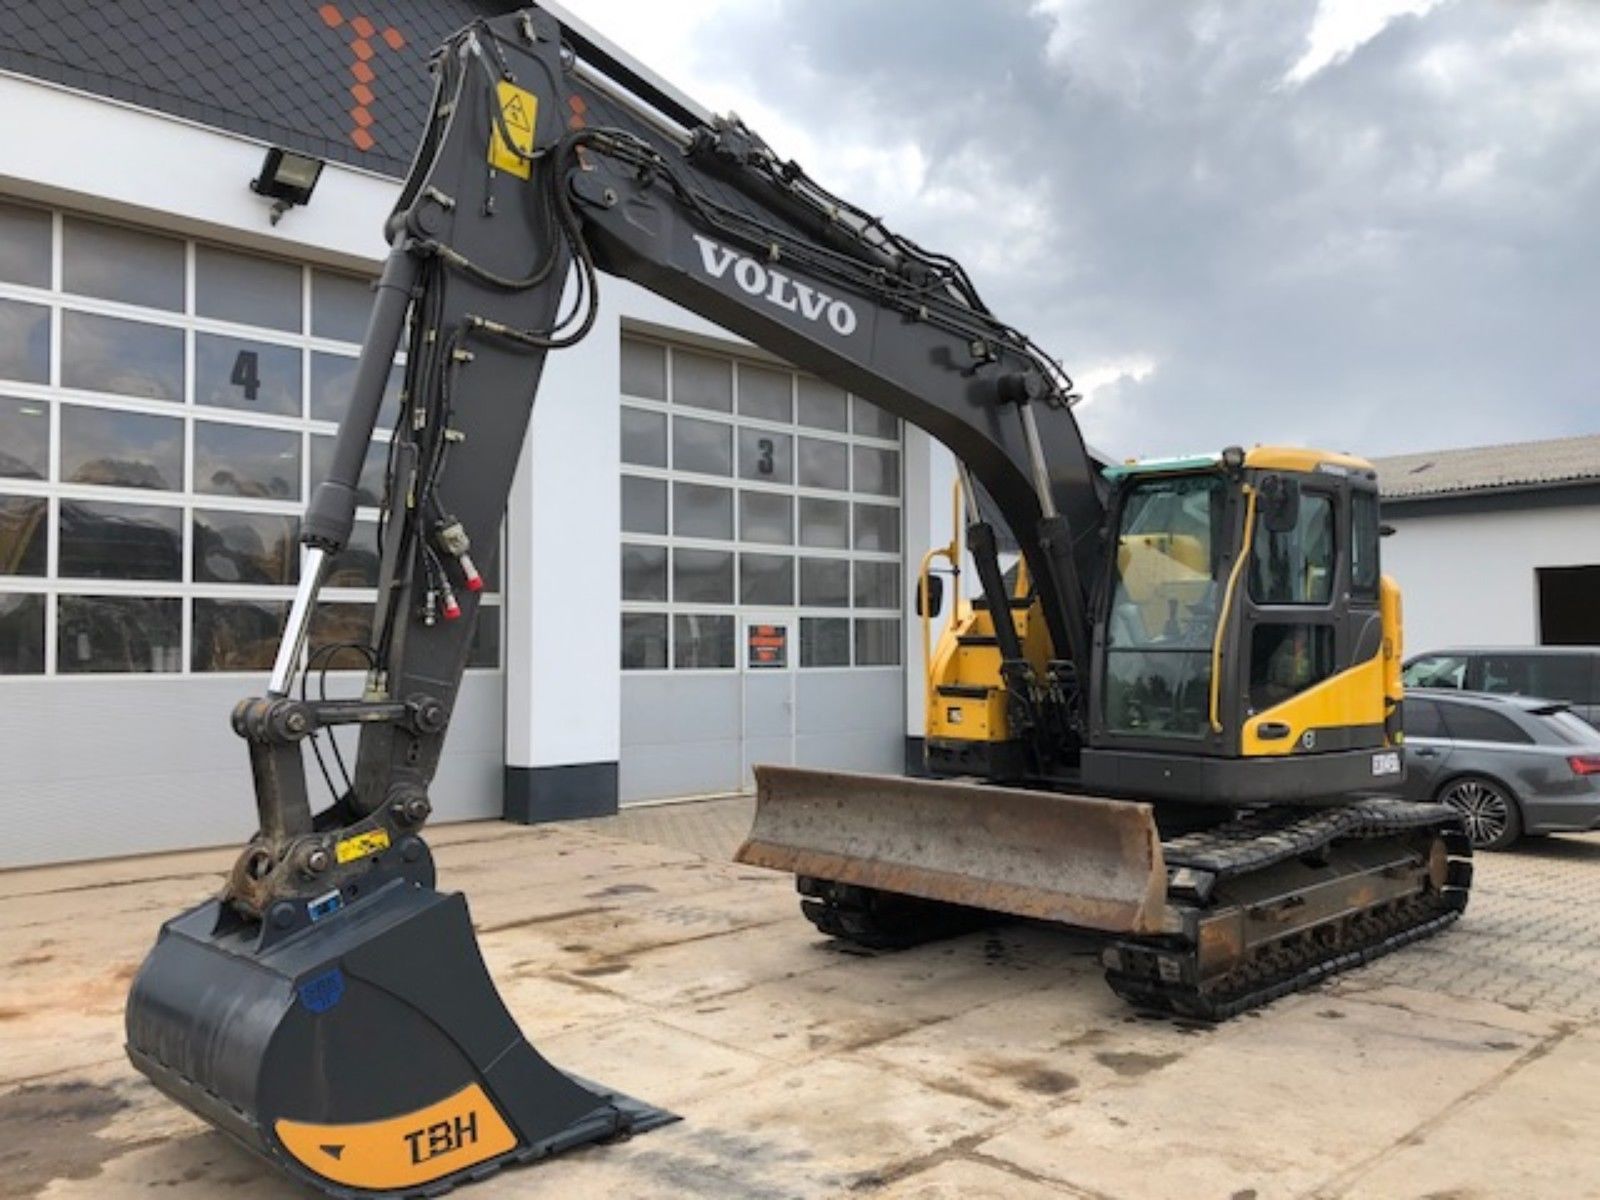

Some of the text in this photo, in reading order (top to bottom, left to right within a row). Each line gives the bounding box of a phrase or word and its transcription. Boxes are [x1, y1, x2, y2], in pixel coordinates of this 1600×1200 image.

[692, 234, 857, 336] VOLVO
[231, 350, 261, 400] 4
[758, 439, 774, 474] 3
[404, 1111, 478, 1164] TBH
